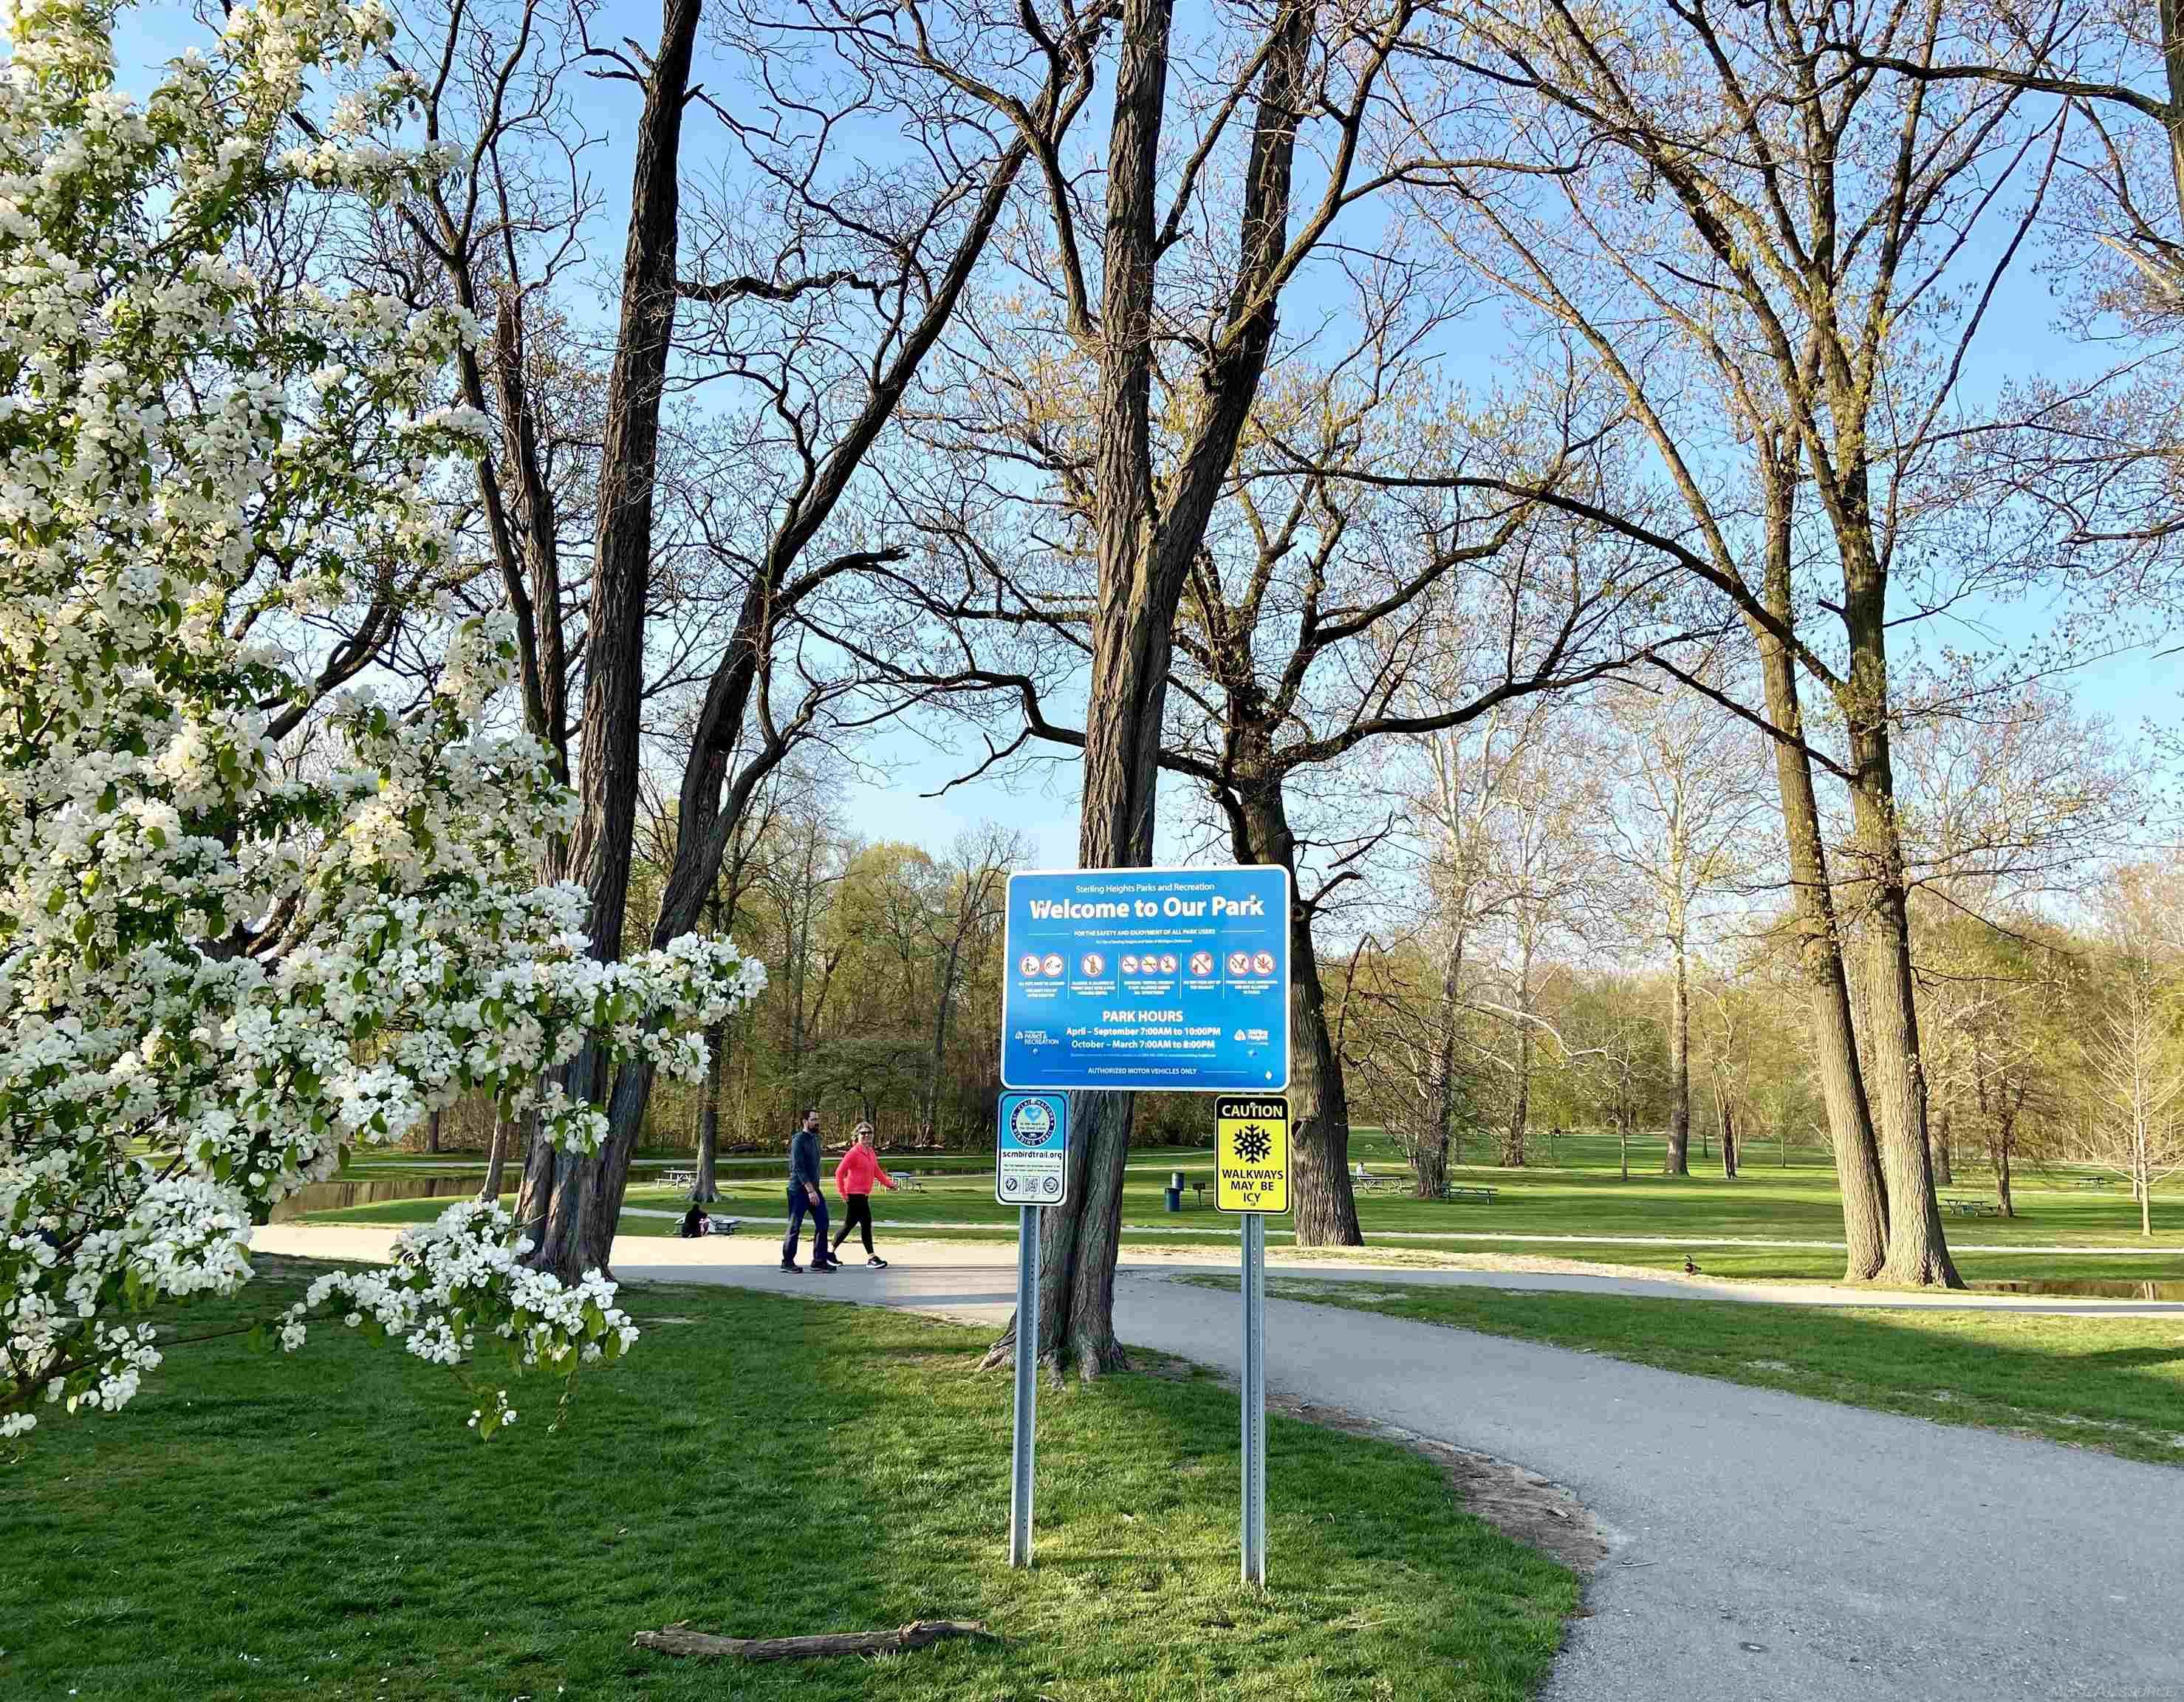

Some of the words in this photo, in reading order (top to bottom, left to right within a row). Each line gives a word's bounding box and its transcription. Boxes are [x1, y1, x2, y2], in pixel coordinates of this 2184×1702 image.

[1075, 885, 1104, 894] Sterling
[1106, 884, 1134, 893] Heights
[1137, 884, 1157, 892] Parks
[1157, 883, 1172, 892] and
[1174, 882, 1215, 892] Recreation
[1029, 898, 1129, 920] Welcome
[1134, 899, 1158, 918] to
[1163, 897, 1207, 917] Our
[1211, 894, 1264, 916] Park
[1103, 1011, 1137, 1022] PARK
[1138, 1011, 1183, 1022] HOURS
[1067, 1027, 1086, 1037] April
[1093, 1028, 1138, 1037] September
[1140, 1028, 1172, 1036] 7:00AM
[1185, 1027, 1221, 1036] 10:00PM
[1072, 1040, 1104, 1048] October
[1112, 1040, 1137, 1048] March
[1140, 1040, 1171, 1048] 7:00AM
[1222, 1104, 1283, 1117] CAUTION
[1002, 1151, 1062, 1160] scmbirdtrail.org
[1222, 1169, 1284, 1180] WALKWAYS
[1230, 1180, 1255, 1191] MAY
[1261, 1181, 1274, 1191] BE
[1243, 1193, 1262, 1203] ICY
